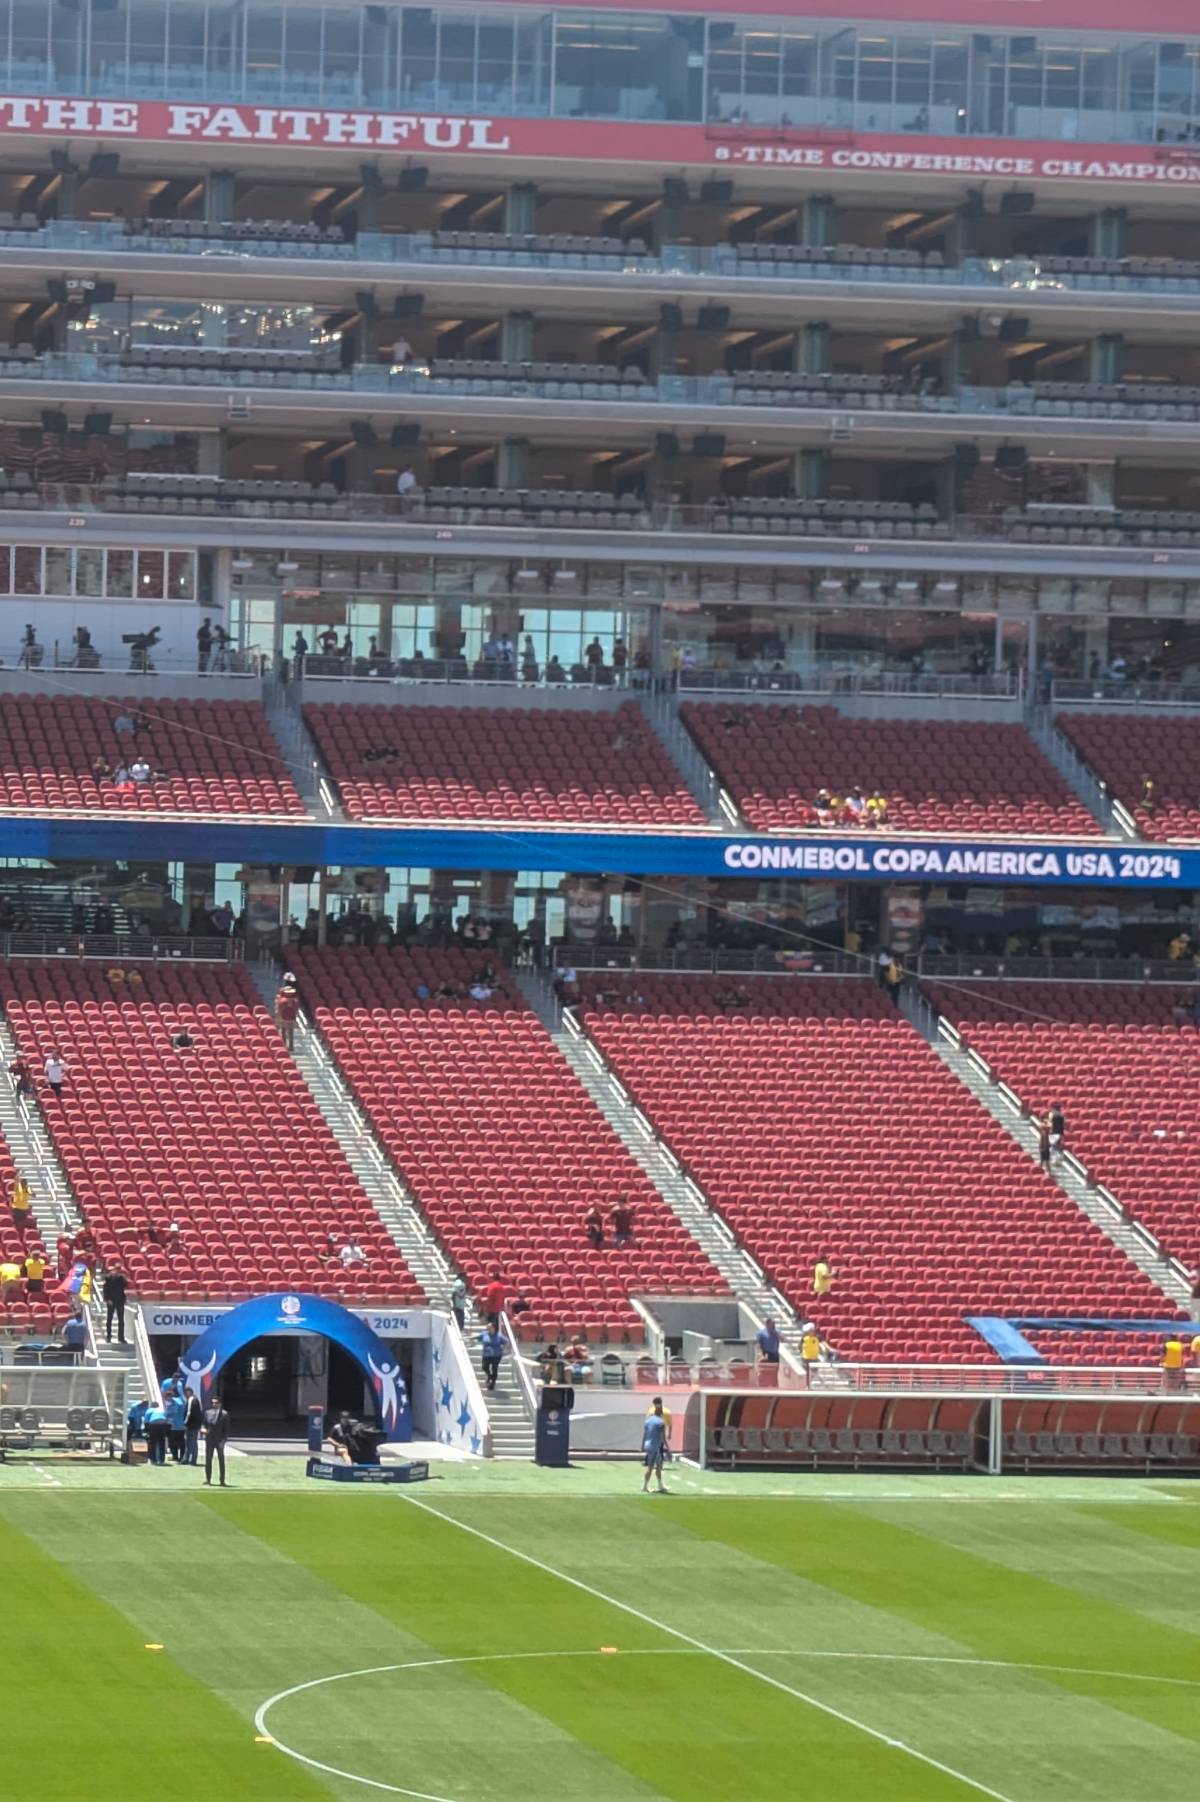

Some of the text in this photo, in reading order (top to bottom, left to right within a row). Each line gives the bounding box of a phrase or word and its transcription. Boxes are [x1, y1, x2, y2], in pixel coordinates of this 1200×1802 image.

[167, 105, 510, 150] FAITHFUL
[831, 150, 1033, 174] CONFERENCE
[724, 844, 1180, 879] CONMEBOL COPA AMERICA USA 2024
[153, 1313, 224, 1326] CONMEB
[373, 1317, 409, 1329] 2024
